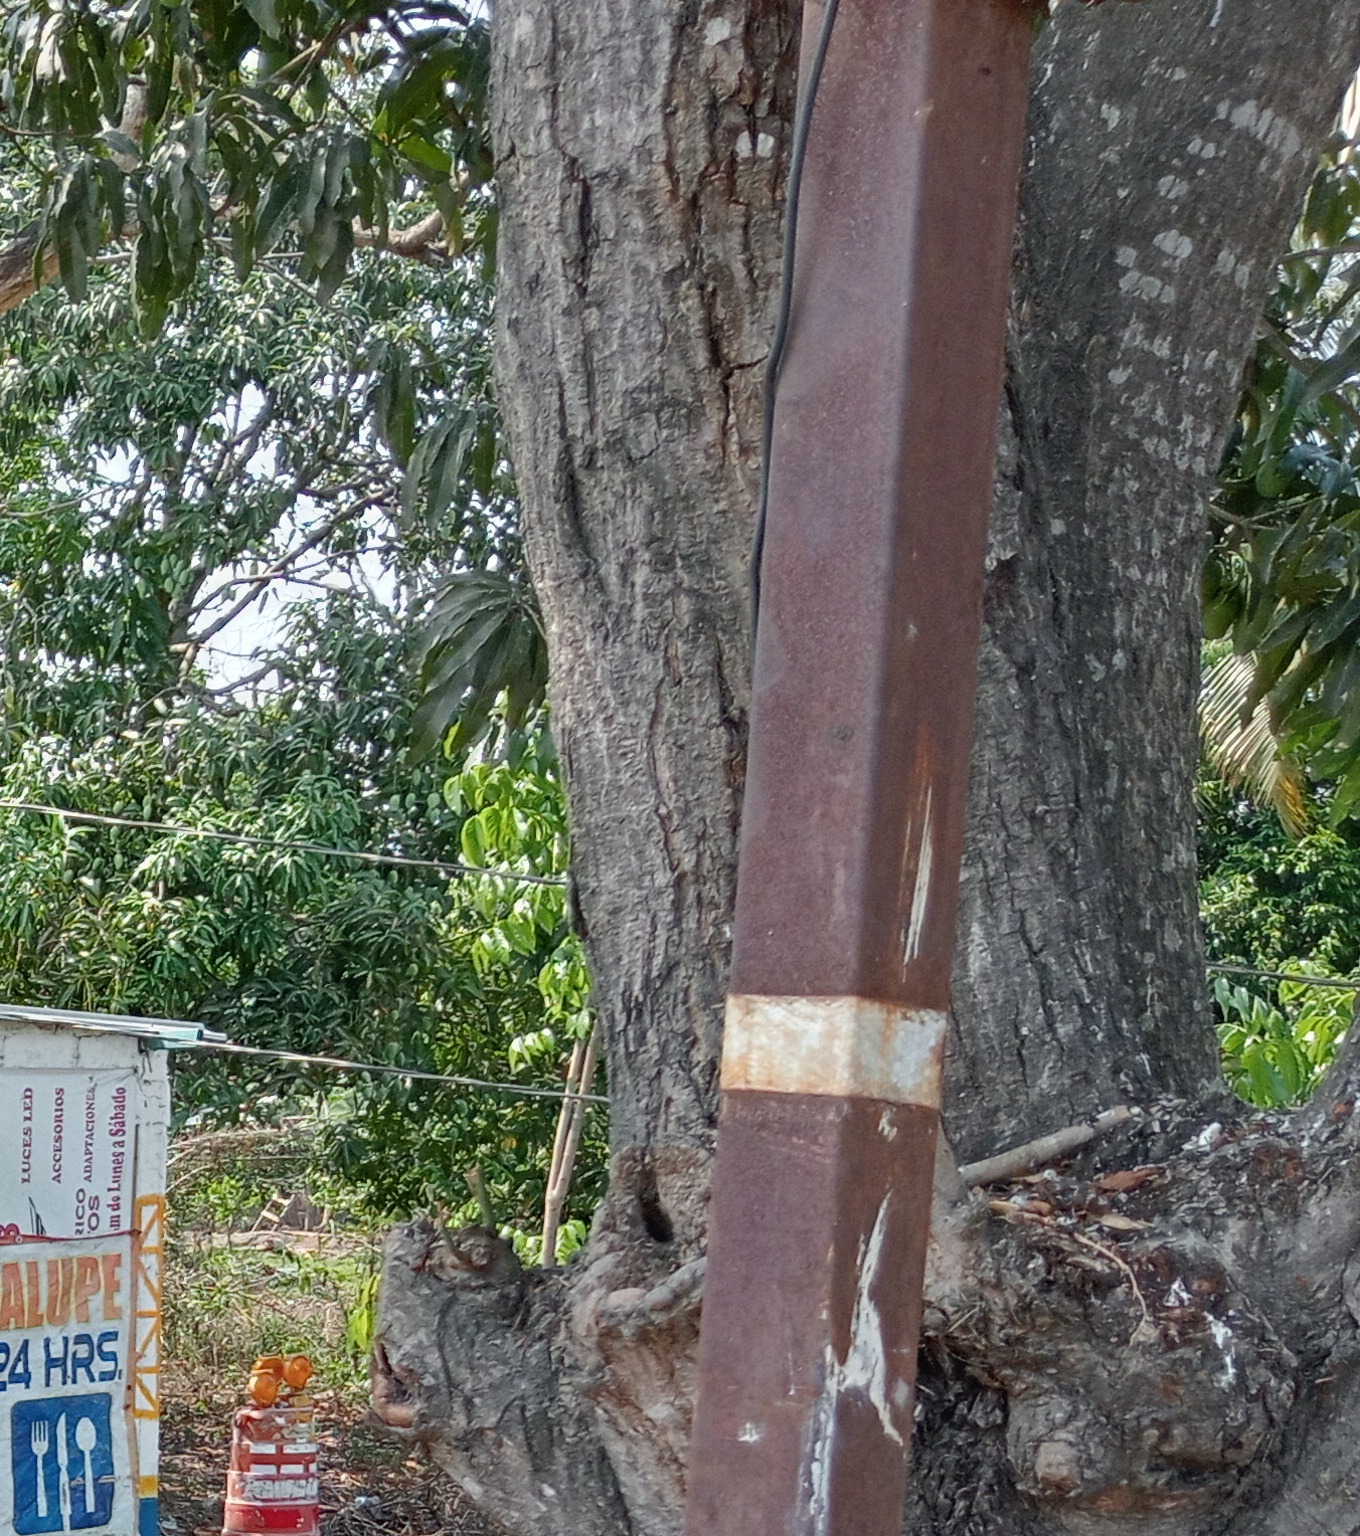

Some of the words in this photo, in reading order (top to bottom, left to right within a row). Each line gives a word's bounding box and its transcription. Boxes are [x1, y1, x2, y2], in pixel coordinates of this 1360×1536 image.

[23, 1087, 33, 1122] LED
[108, 1087, 127, 1137] Sábado
[21, 1126, 32, 1184] LUCES
[52, 1087, 64, 1184] ACCESORIOS
[83, 1087, 96, 1183] ADAPTACIONES
[112, 1139, 125, 1149] a
[106, 1151, 124, 1192] Lunes
[43, 1330, 123, 1388] HRS.
